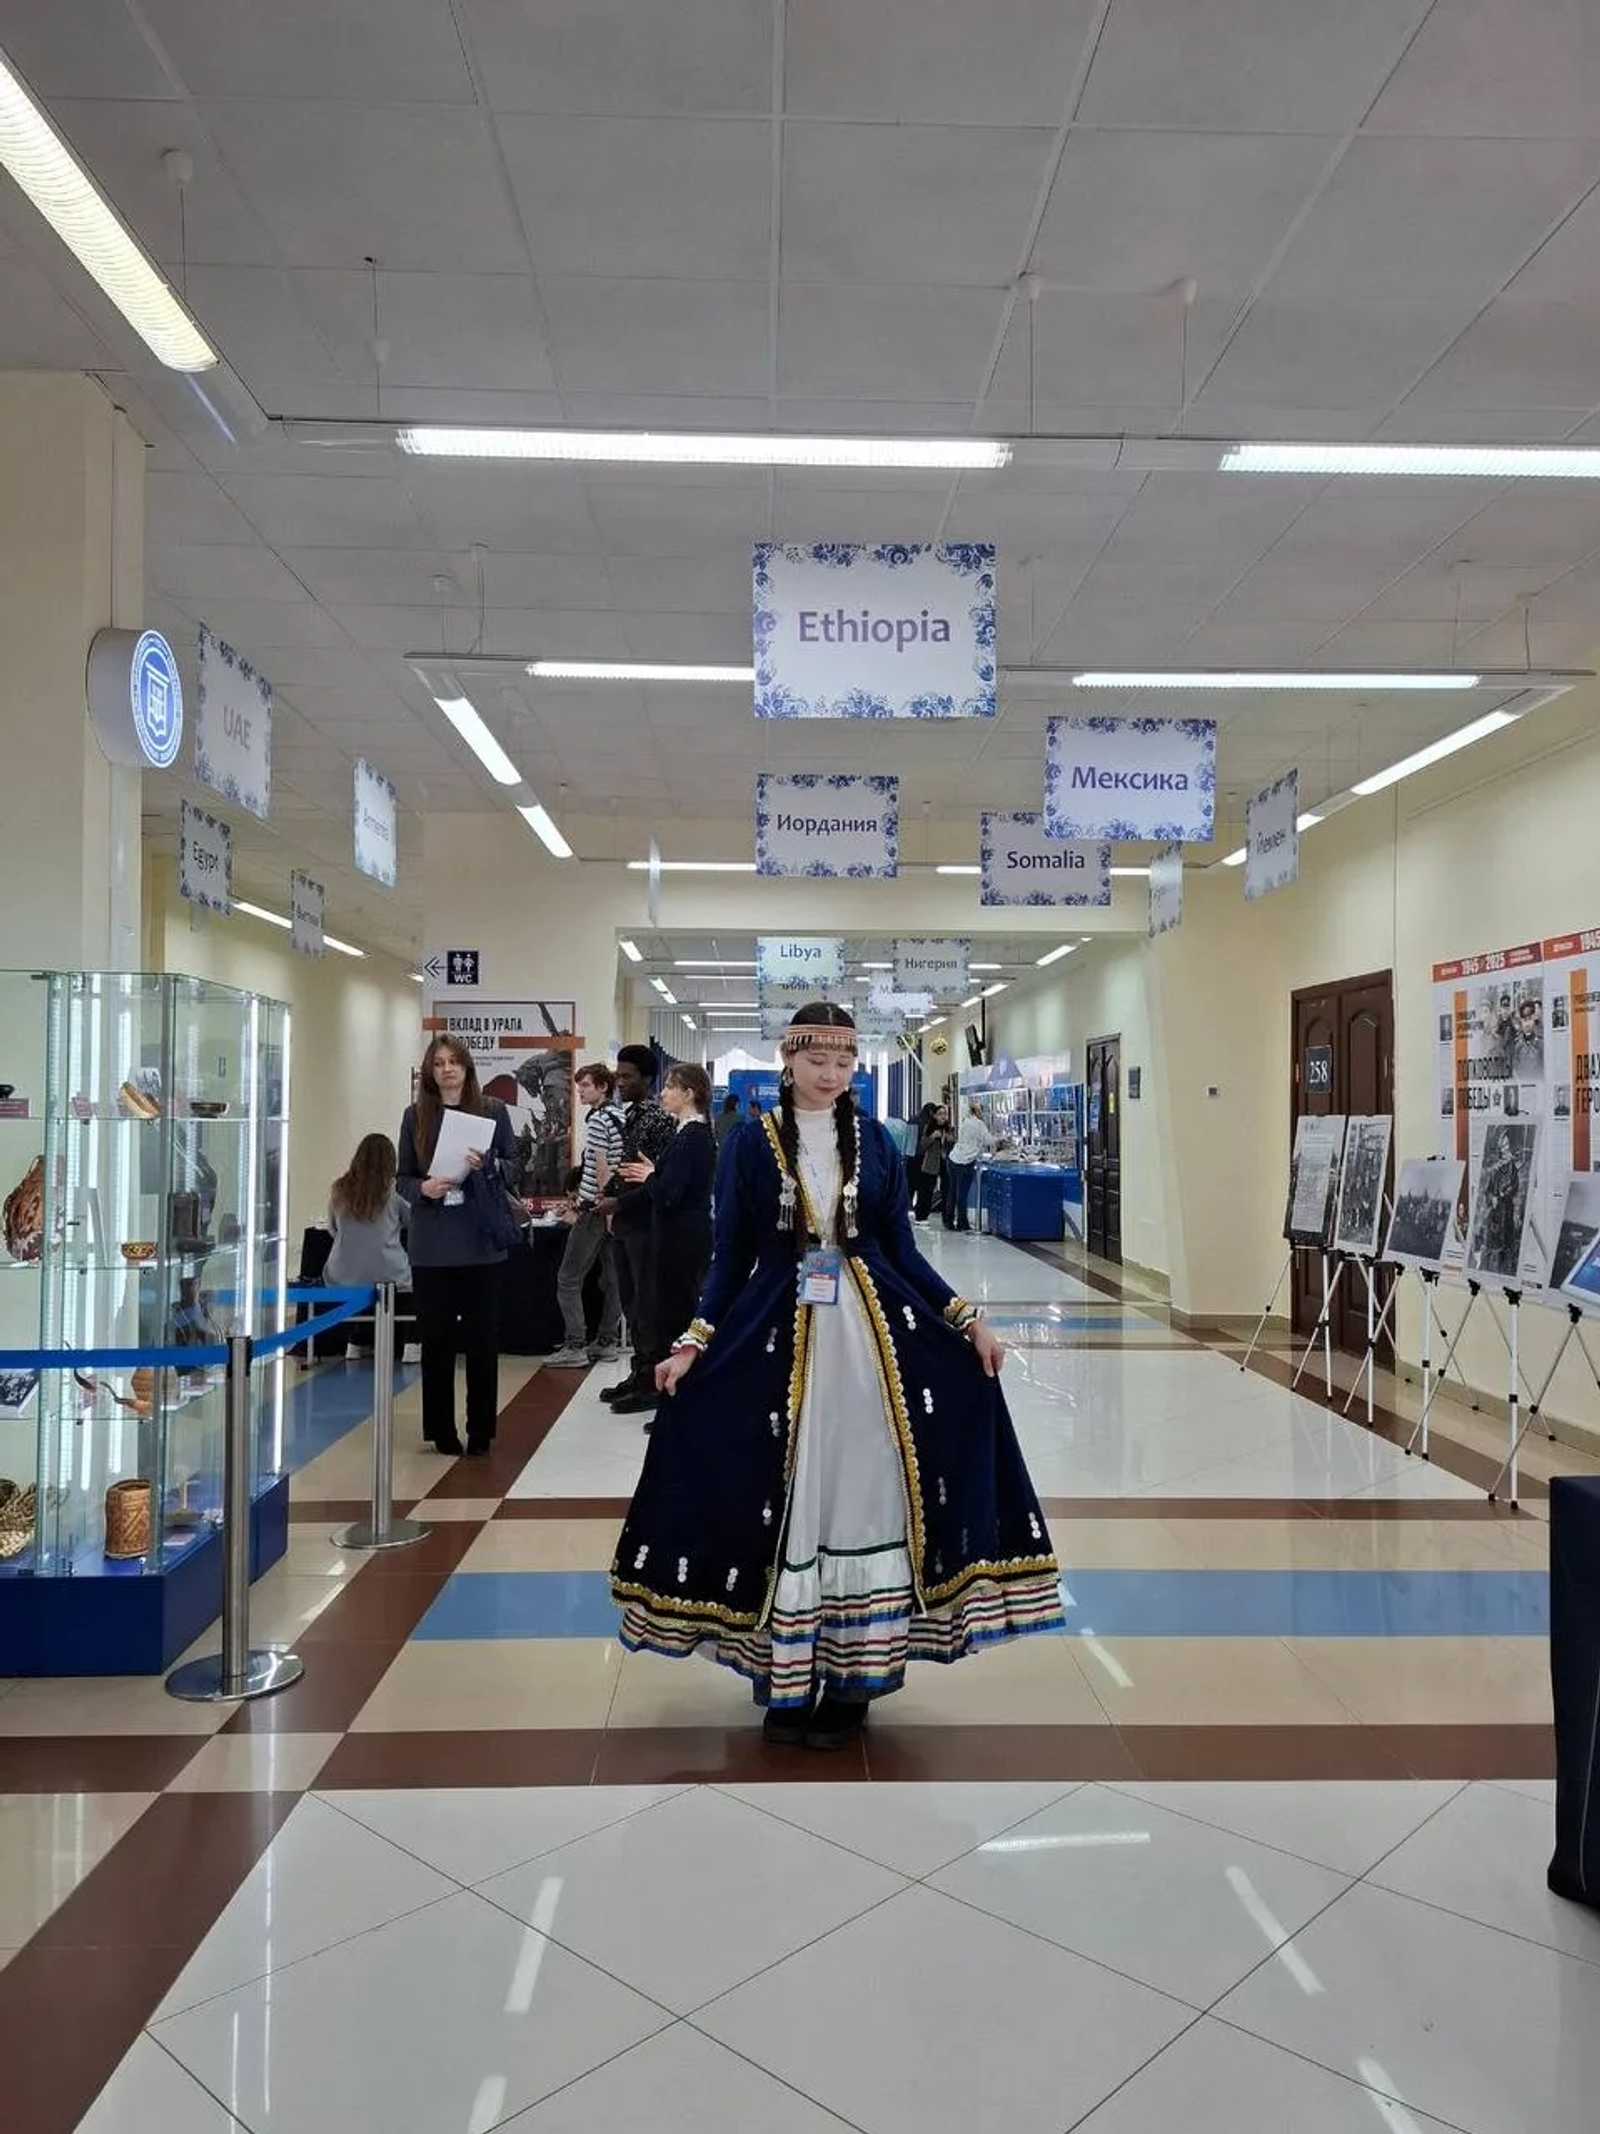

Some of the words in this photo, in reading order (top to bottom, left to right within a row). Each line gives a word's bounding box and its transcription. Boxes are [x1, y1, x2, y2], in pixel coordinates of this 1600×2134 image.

[798, 608, 951, 653] Ethiopia
[223, 704, 252, 750] UAE
[1071, 765, 1189, 791] Мексика
[777, 813, 877, 836] Иордания
[1006, 850, 1085, 870] Somalia
[780, 943, 822, 962] Libya
[905, 957, 958, 973] Нигерия
[453, 974, 473, 984] WC
[1309, 1060, 1328, 1083] 258
